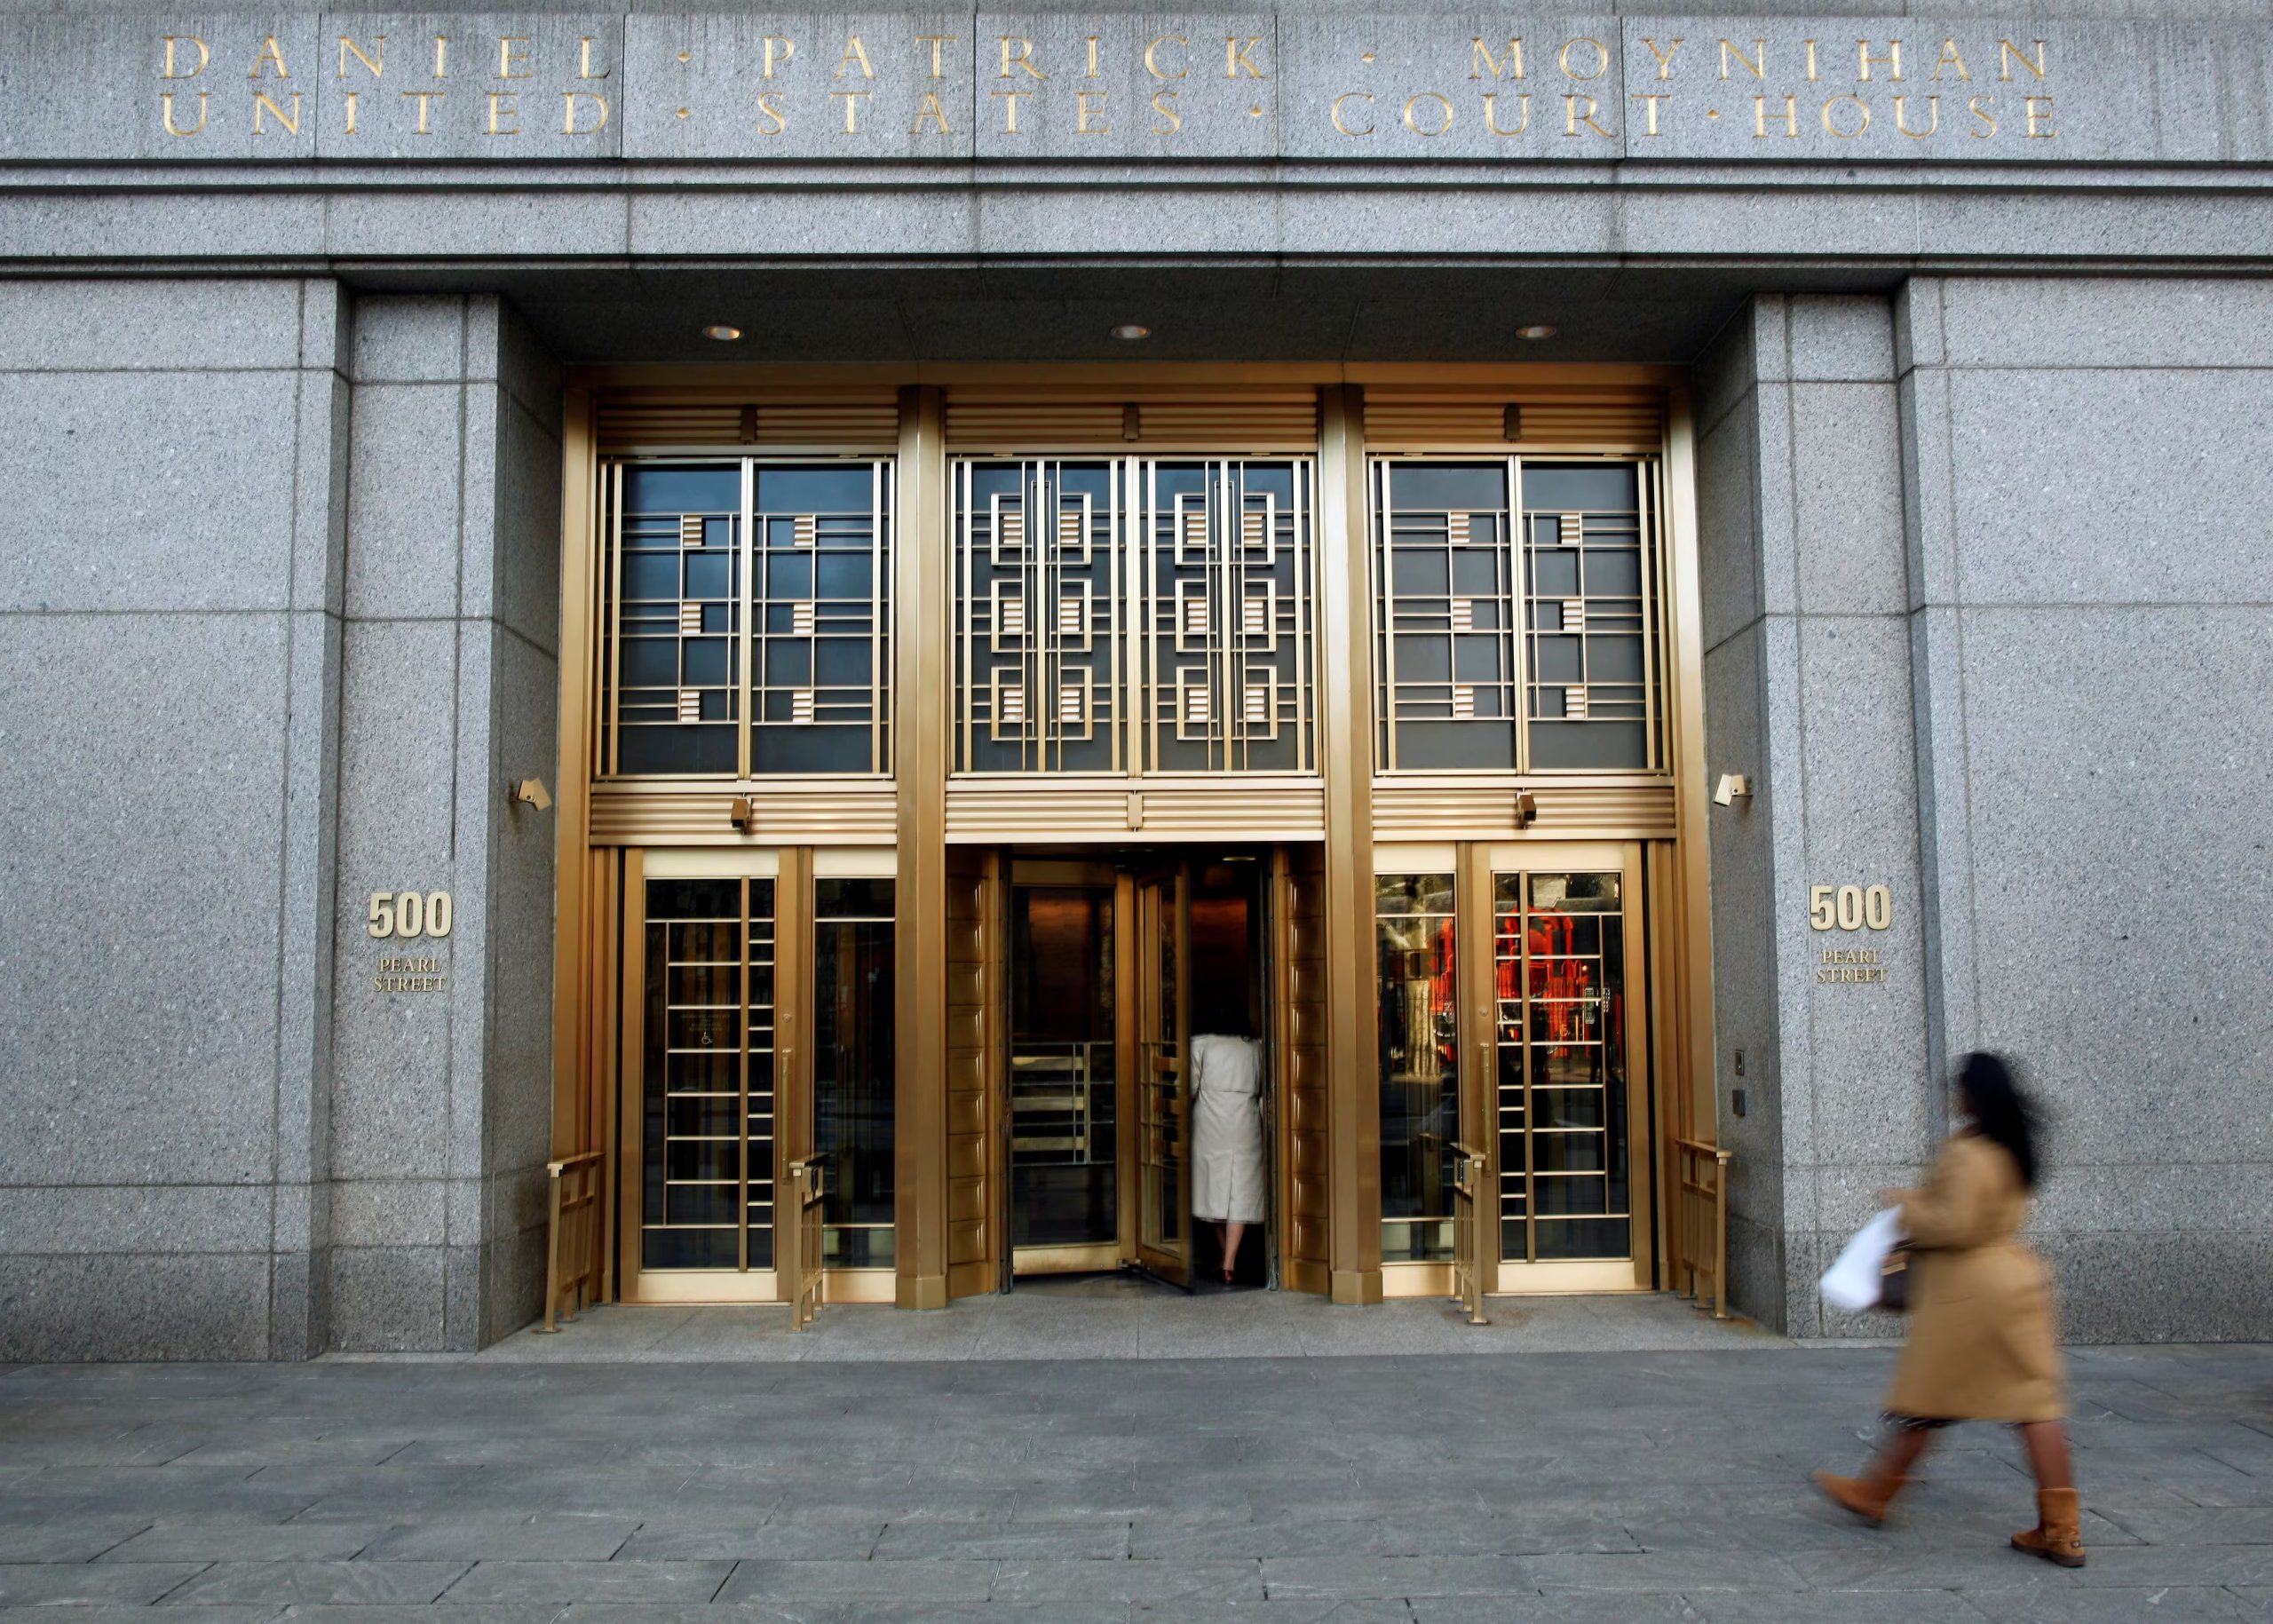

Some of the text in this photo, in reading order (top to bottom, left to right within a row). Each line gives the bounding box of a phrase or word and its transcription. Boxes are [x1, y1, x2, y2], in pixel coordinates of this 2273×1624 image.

[159, 35, 2050, 82] DANIEL PATRICK MOYNIHAN
[159, 91, 2059, 139] UNITED STATES COURT HOUSE
[368, 891, 453, 938] 500
[1810, 884, 1891, 931] 500
[379, 958, 443, 972] PEARL
[1820, 949, 1882, 964] PEARL
[373, 977, 447, 992] STREET
[1816, 967, 1889, 983] STREET
